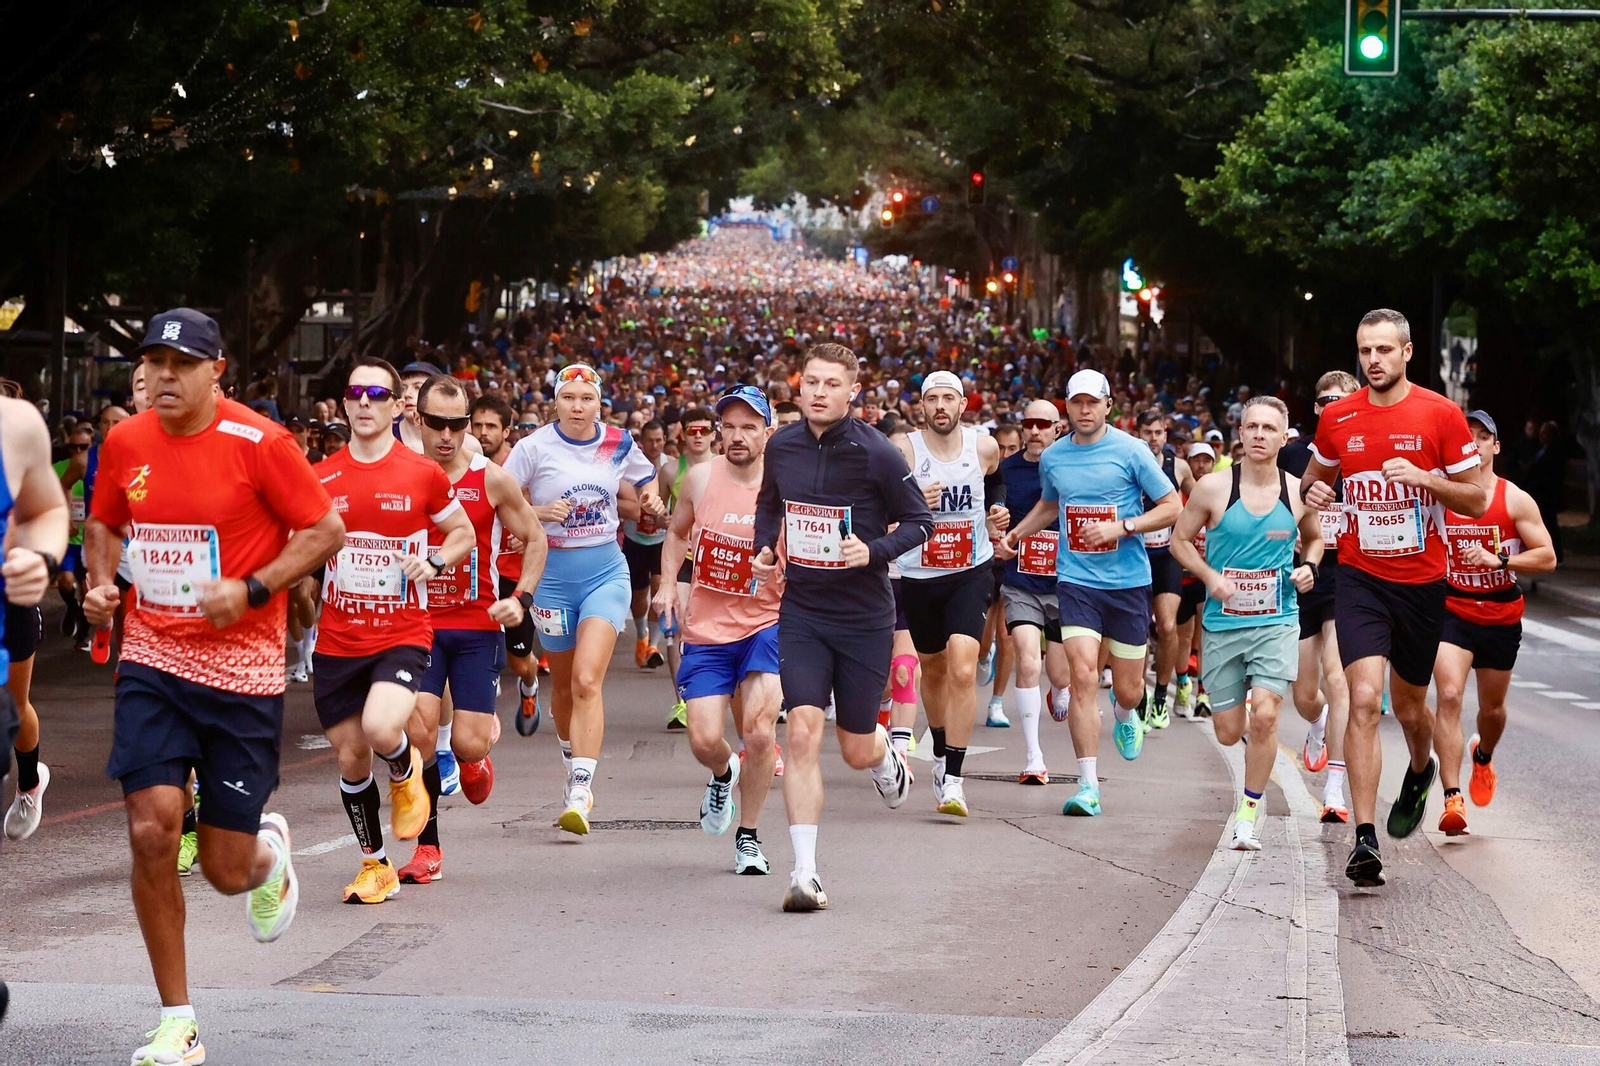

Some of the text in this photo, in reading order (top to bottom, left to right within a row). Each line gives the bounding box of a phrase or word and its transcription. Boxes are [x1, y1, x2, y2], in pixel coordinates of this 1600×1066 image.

[1075, 506, 1108, 514] GENERALI
[1371, 500, 1410, 511] GENERALI
[801, 505, 840, 518] GENERALI
[1368, 513, 1406, 526] 29655
[797, 519, 832, 534] 17641
[934, 522, 970, 530] GENERALI
[145, 528, 201, 542] GENERALI
[566, 527, 605, 537] NORWAY
[933, 532, 962, 543] 4064
[1034, 531, 1059, 540] GENERA
[1456, 528, 1490, 536] GENERALI
[355, 540, 398, 550] GENERALI
[715, 535, 755, 550] GENERALI
[1030, 541, 1055, 551] 5369
[1456, 538, 1483, 549] 3046
[141, 549, 194, 565] 18424
[350, 552, 391, 566] 17579
[710, 547, 742, 563] 4554
[1238, 570, 1273, 579] GENERALI
[1234, 581, 1268, 592] 16545
